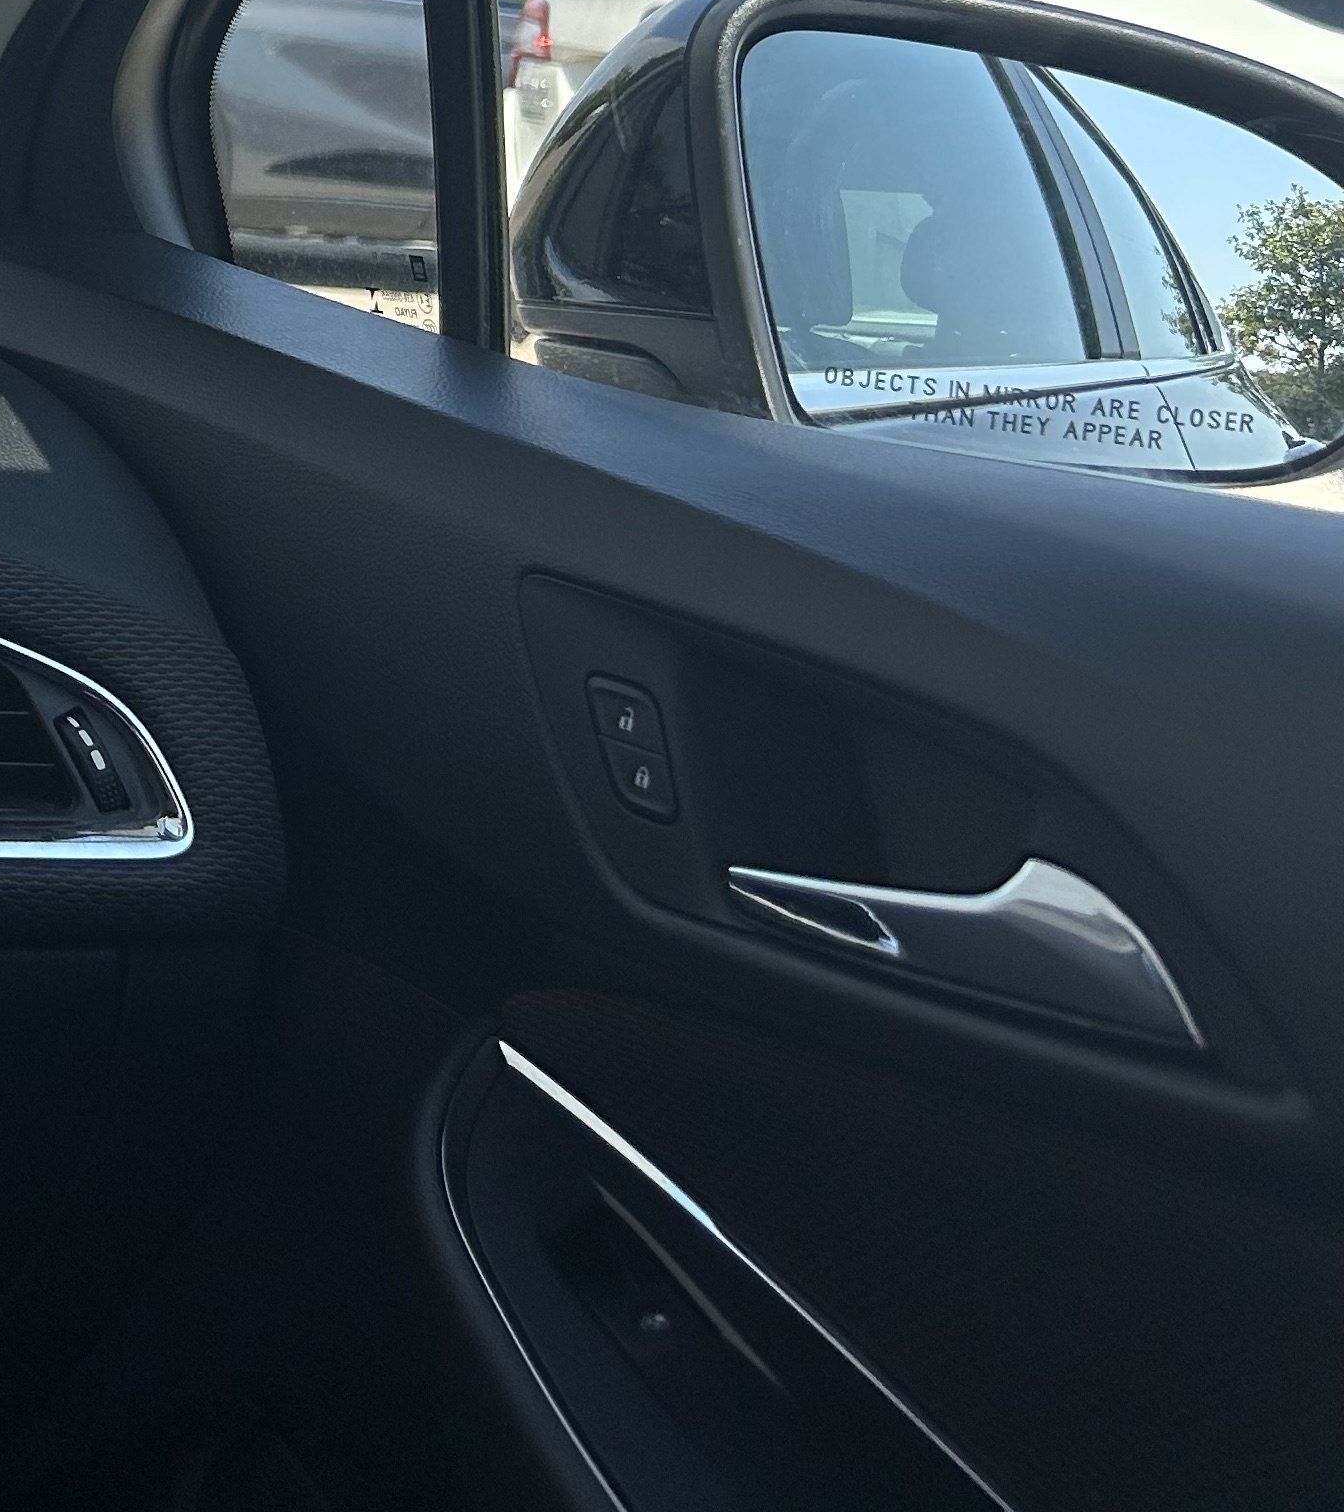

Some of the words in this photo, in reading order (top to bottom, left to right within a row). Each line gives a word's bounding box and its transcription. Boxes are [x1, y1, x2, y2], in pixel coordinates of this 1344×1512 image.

[824, 365, 938, 398] OBJECTS
[949, 380, 971, 400] IN
[982, 384, 1078, 414] MIRROR
[1090, 397, 1142, 421] ARE
[1156, 402, 1256, 435] CLOSER
[909, 401, 976, 429] THAN
[987, 410, 1052, 437] THEY
[1064, 418, 1164, 451] APPEAR
